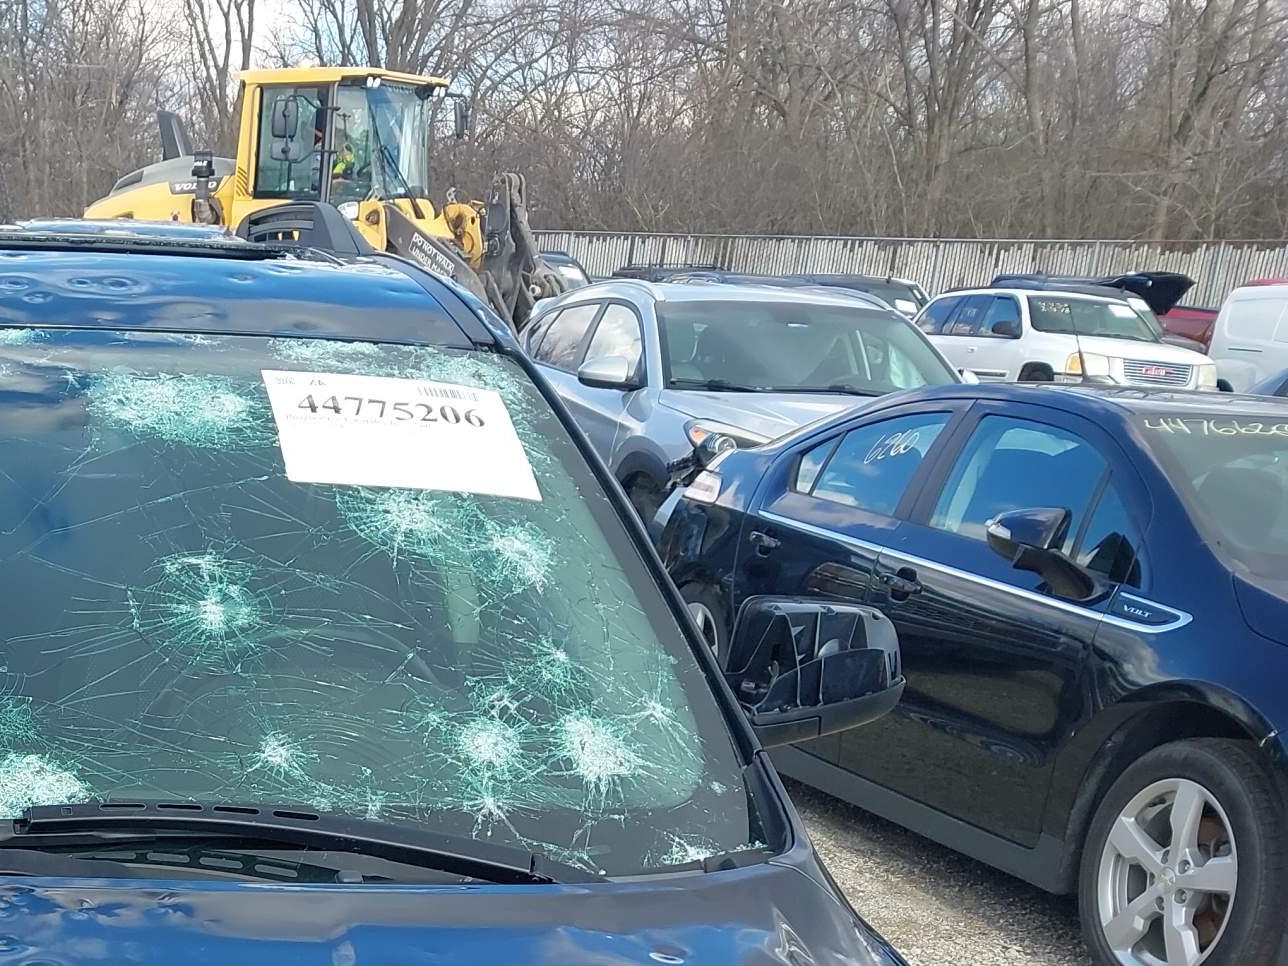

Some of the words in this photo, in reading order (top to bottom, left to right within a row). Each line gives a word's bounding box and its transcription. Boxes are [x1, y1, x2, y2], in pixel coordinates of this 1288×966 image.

[174, 181, 218, 190] VOLO
[413, 235, 423, 246] DO
[422, 241, 436, 256] NOT
[436, 251, 455, 271] WALK
[297, 394, 486, 428] 44775206
[1124, 604, 1152, 618] VOLT
